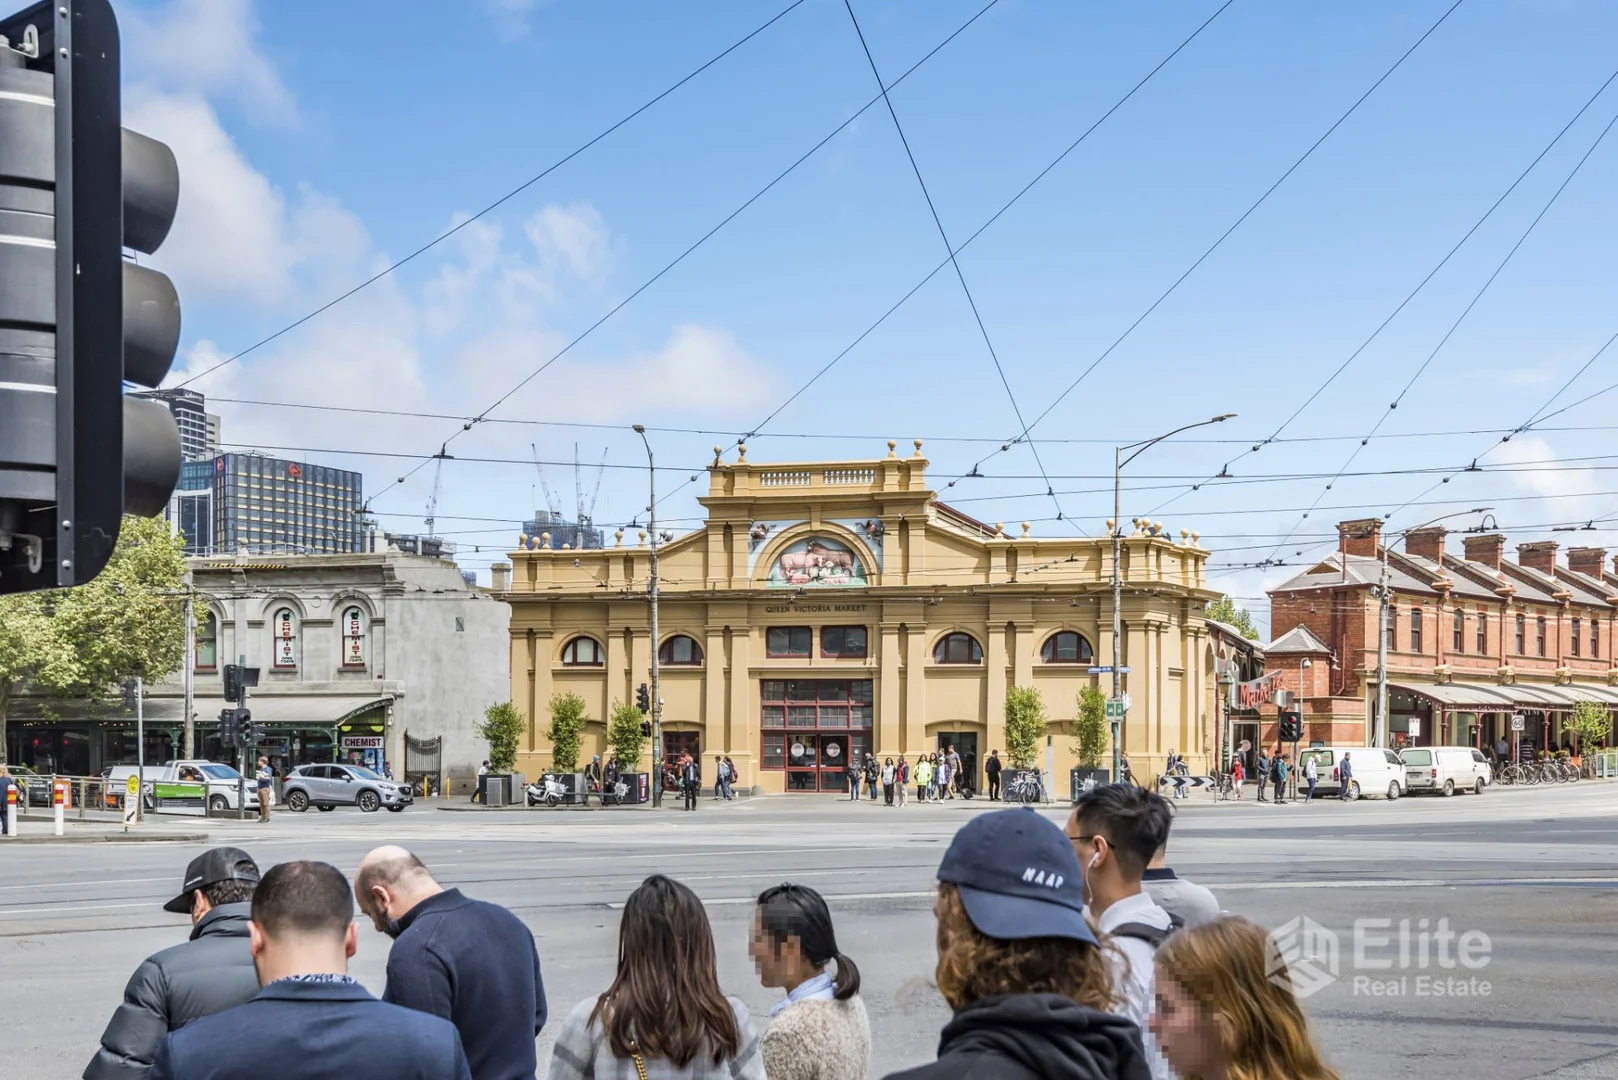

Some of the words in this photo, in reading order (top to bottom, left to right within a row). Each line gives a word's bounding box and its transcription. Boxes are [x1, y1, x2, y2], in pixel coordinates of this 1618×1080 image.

[765, 605, 790, 613] QUEEN
[794, 605, 831, 613] VICTORIA
[834, 604, 867, 612] MARKET
[282, 621, 292, 656] CHEMIST
[350, 620, 360, 655] CHEMIST
[1239, 682, 1271, 708] Market
[344, 738, 382, 747] CHEMIST
